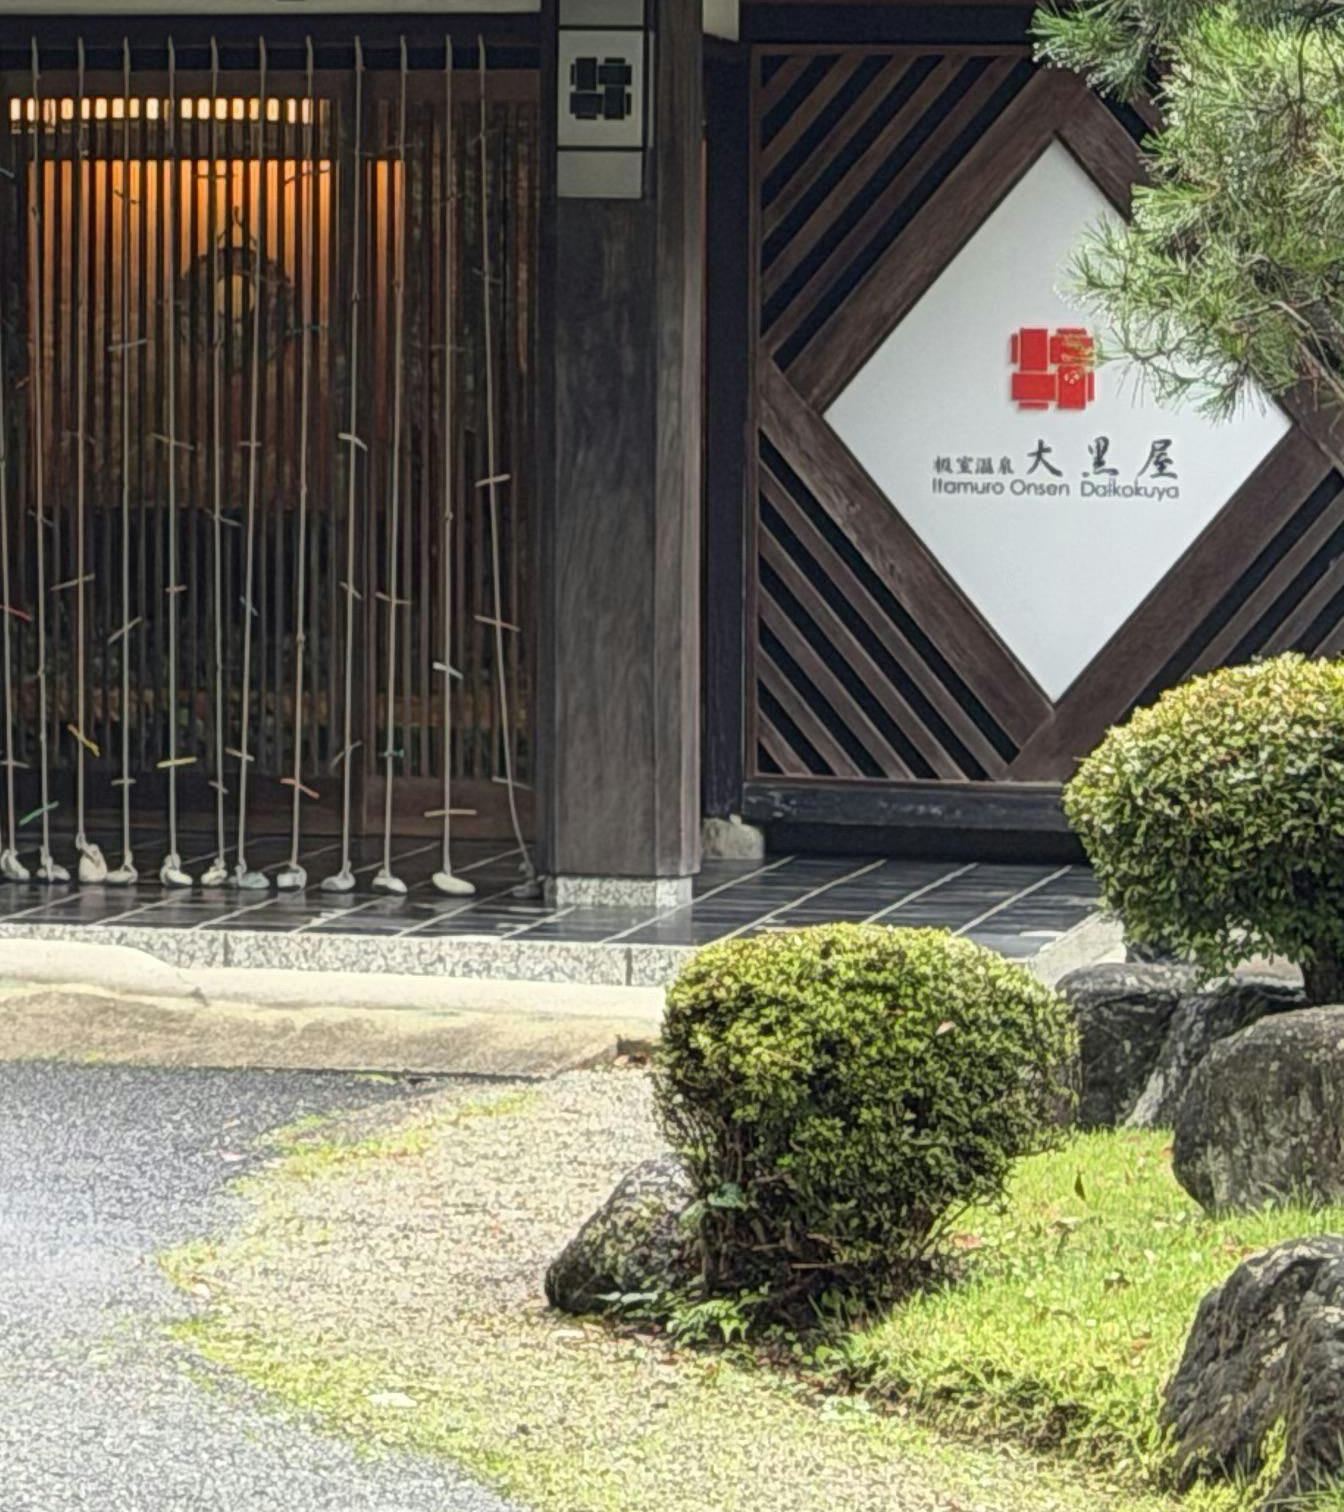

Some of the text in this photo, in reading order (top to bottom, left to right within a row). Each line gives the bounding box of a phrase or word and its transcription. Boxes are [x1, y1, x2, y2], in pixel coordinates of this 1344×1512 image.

[1026, 436, 1178, 479] 大黒屋
[932, 477, 1180, 502] Itamuro Onsen Daikokuya
